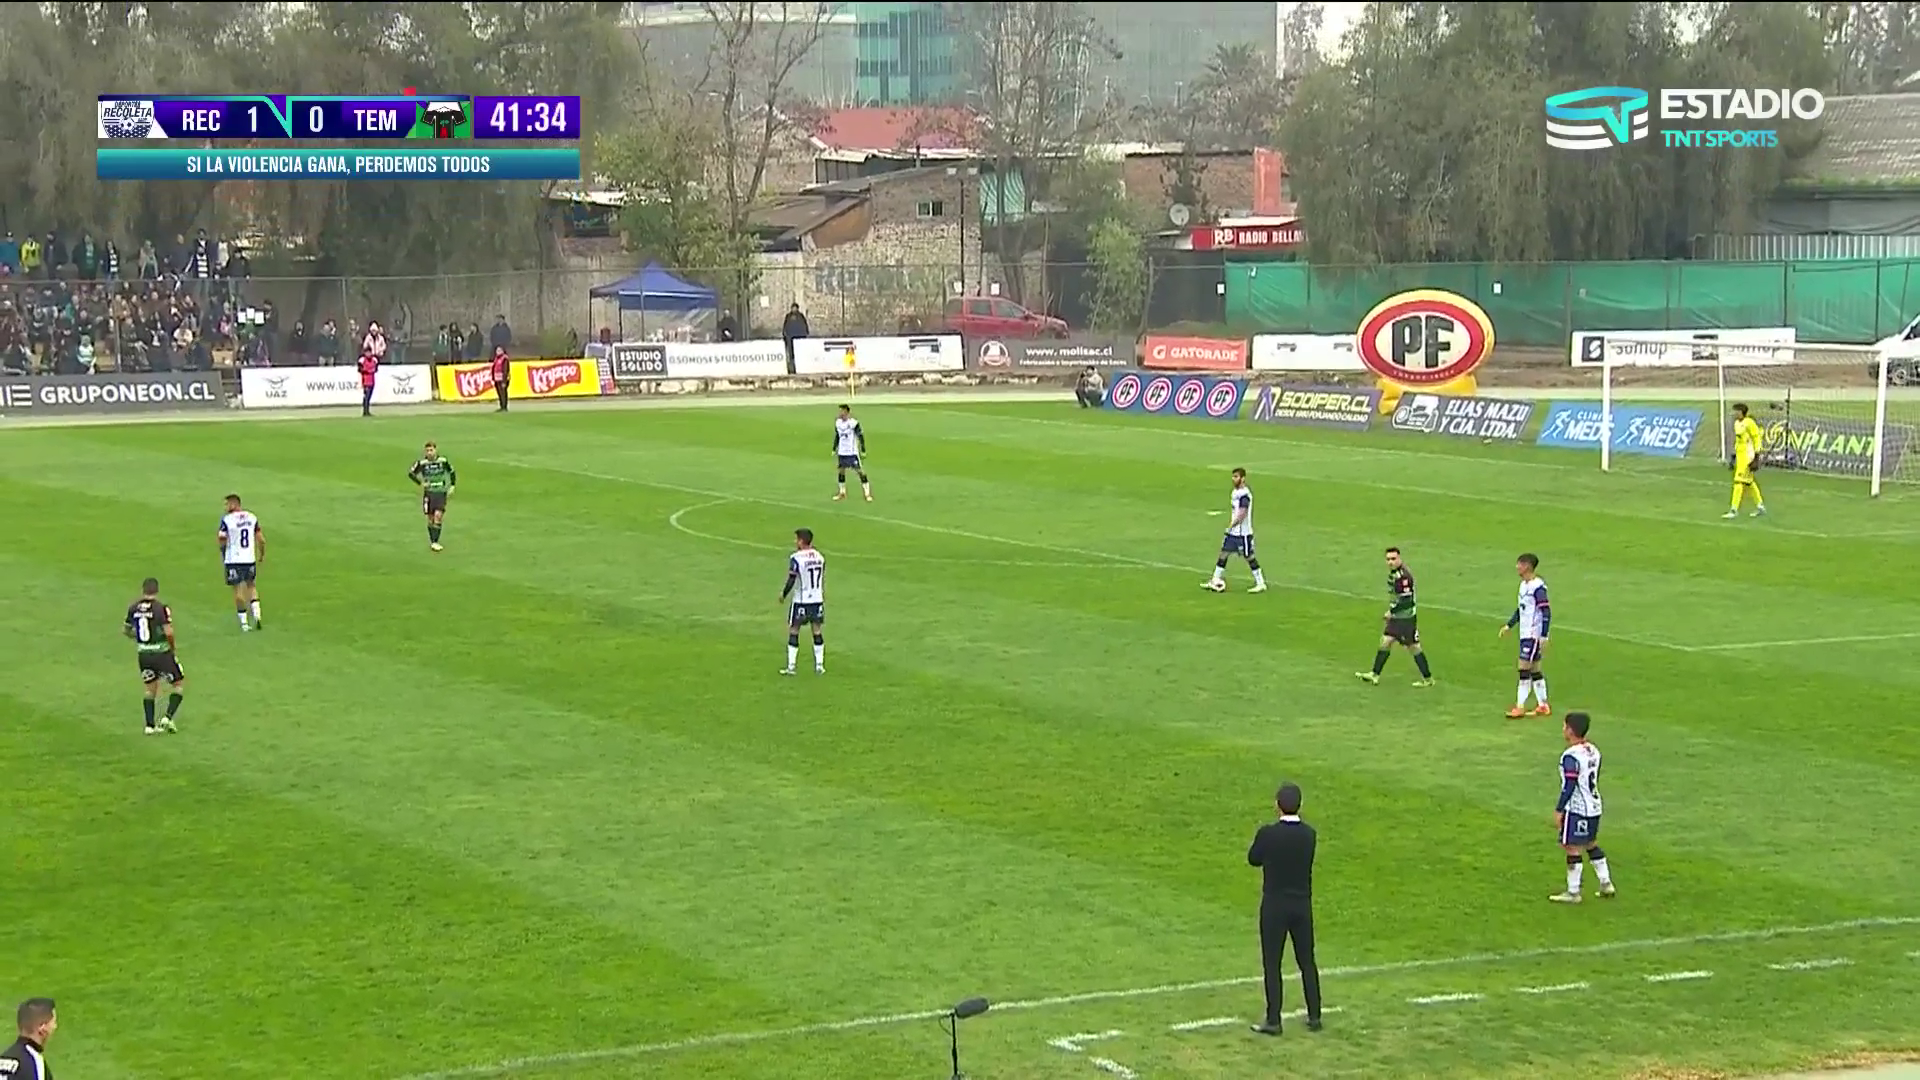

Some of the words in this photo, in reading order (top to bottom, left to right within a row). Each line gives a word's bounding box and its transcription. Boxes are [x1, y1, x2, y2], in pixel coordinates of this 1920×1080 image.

[1239, 230, 1268, 245] RADIO
[1391, 314, 1455, 369] PF
[619, 350, 662, 362] ESTUDIO
[1170, 346, 1239, 361] GATORADE
[531, 364, 578, 394] Kryzpo
[40, 381, 215, 404] GRUPONEON.CL
[265, 389, 288, 399] UAZ
[392, 386, 415, 395] UAZ
[1279, 390, 1373, 413] SODIPER.CL
[1444, 399, 1485, 417] ELIAS
[1484, 402, 1530, 421] MAZU
[1478, 419, 1518, 439] LTDA.
[1652, 416, 1692, 428] CLINICA
[1638, 426, 1694, 449] MEDS
[240, 528, 249, 549] 8
[807, 567, 822, 590] 17
